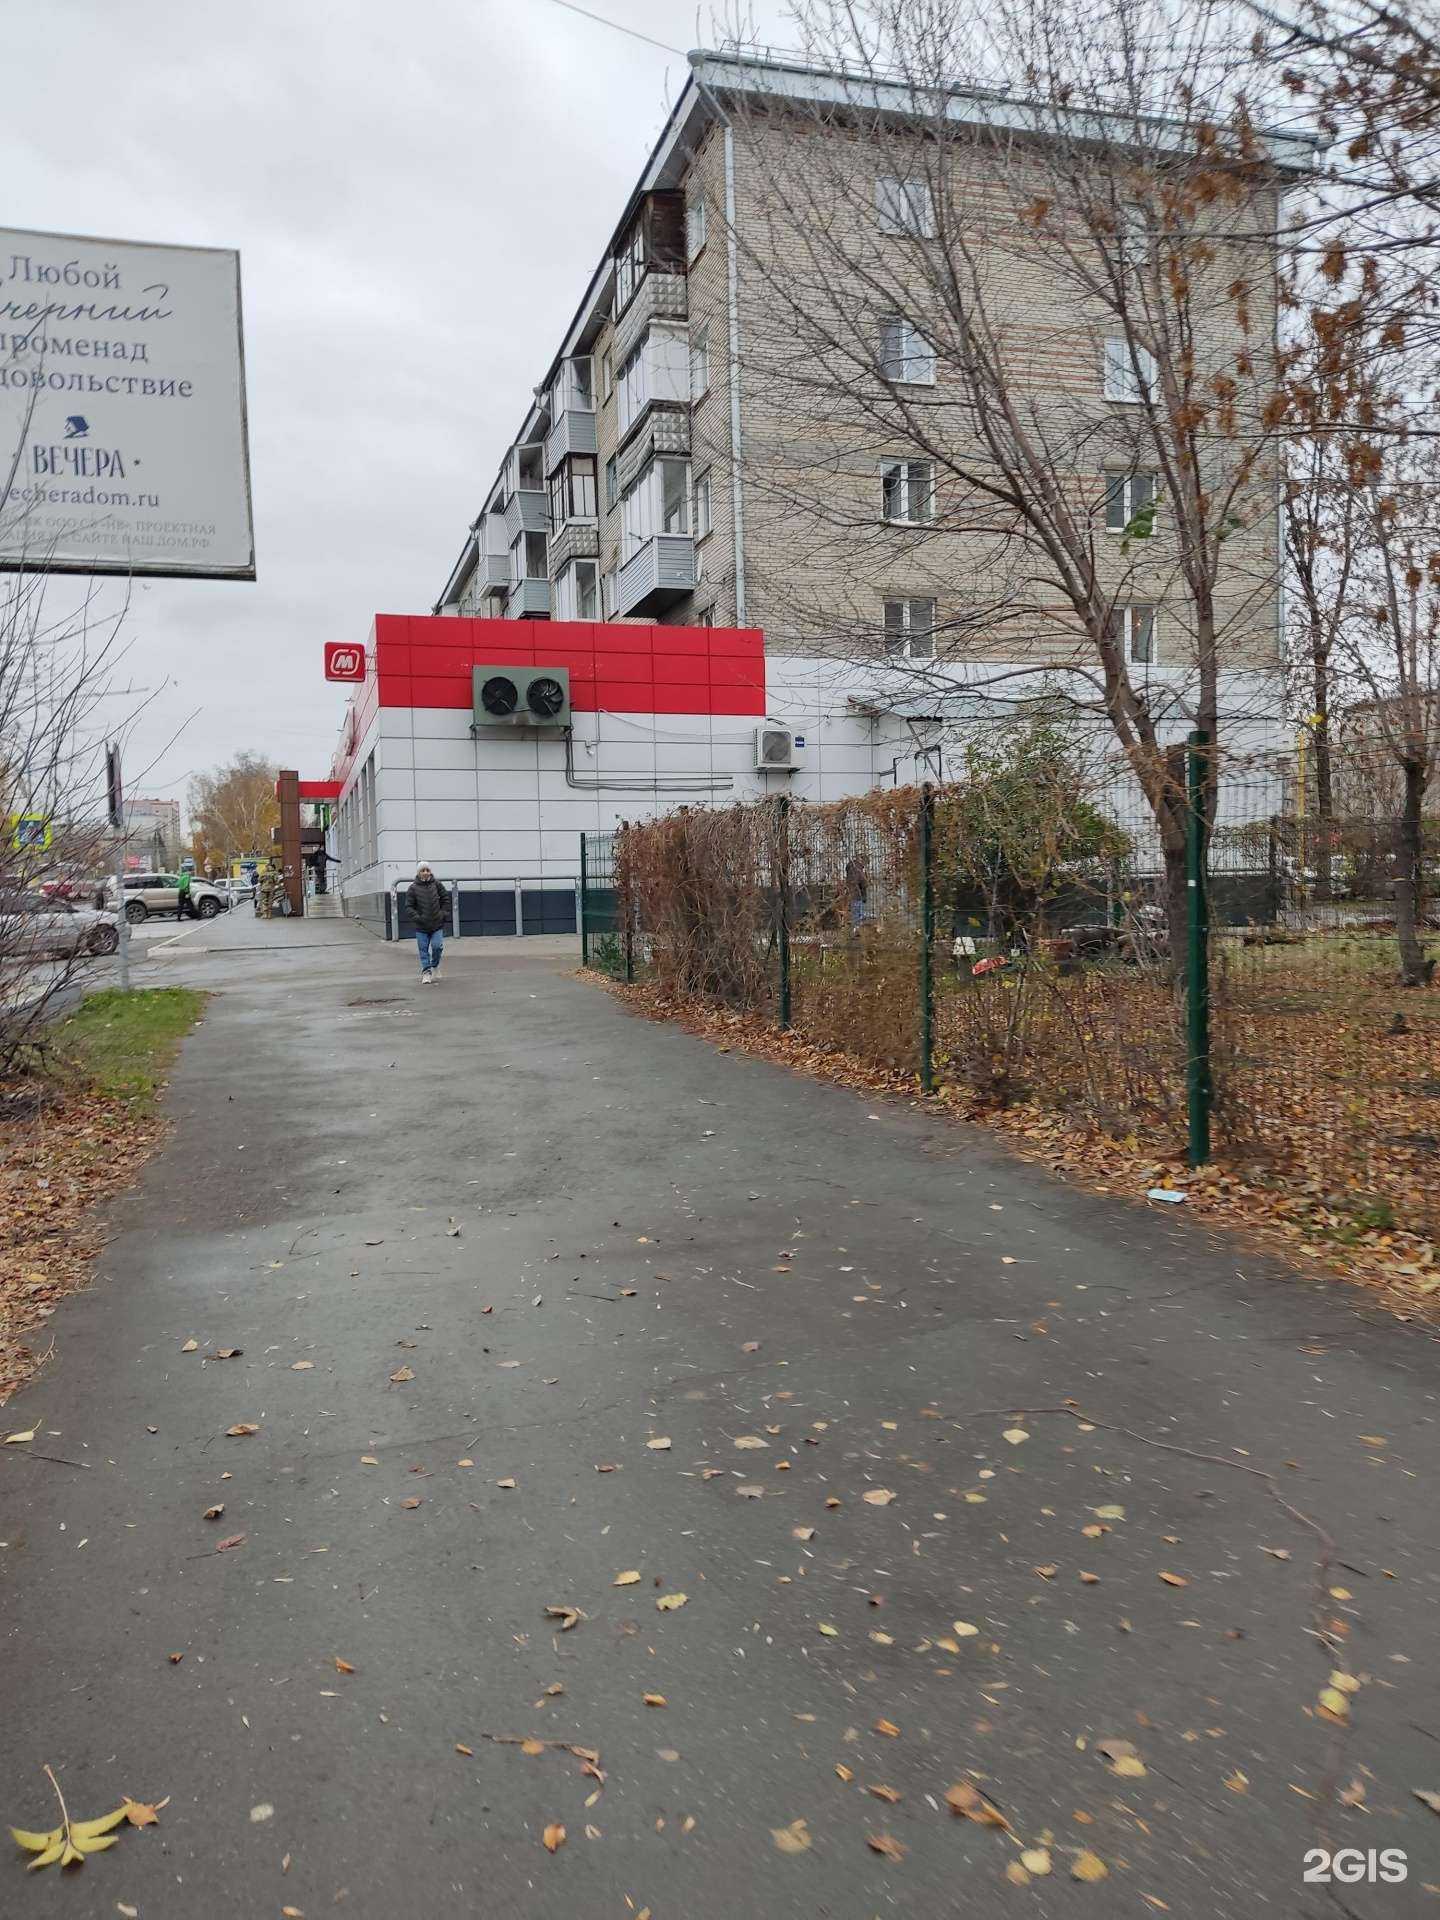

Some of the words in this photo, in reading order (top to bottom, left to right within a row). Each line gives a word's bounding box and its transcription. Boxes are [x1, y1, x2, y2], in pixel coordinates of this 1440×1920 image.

[9, 255, 122, 289] Любой
[0, 284, 174, 348] черний
[33, 445, 126, 479] ВЕЧЕРА
